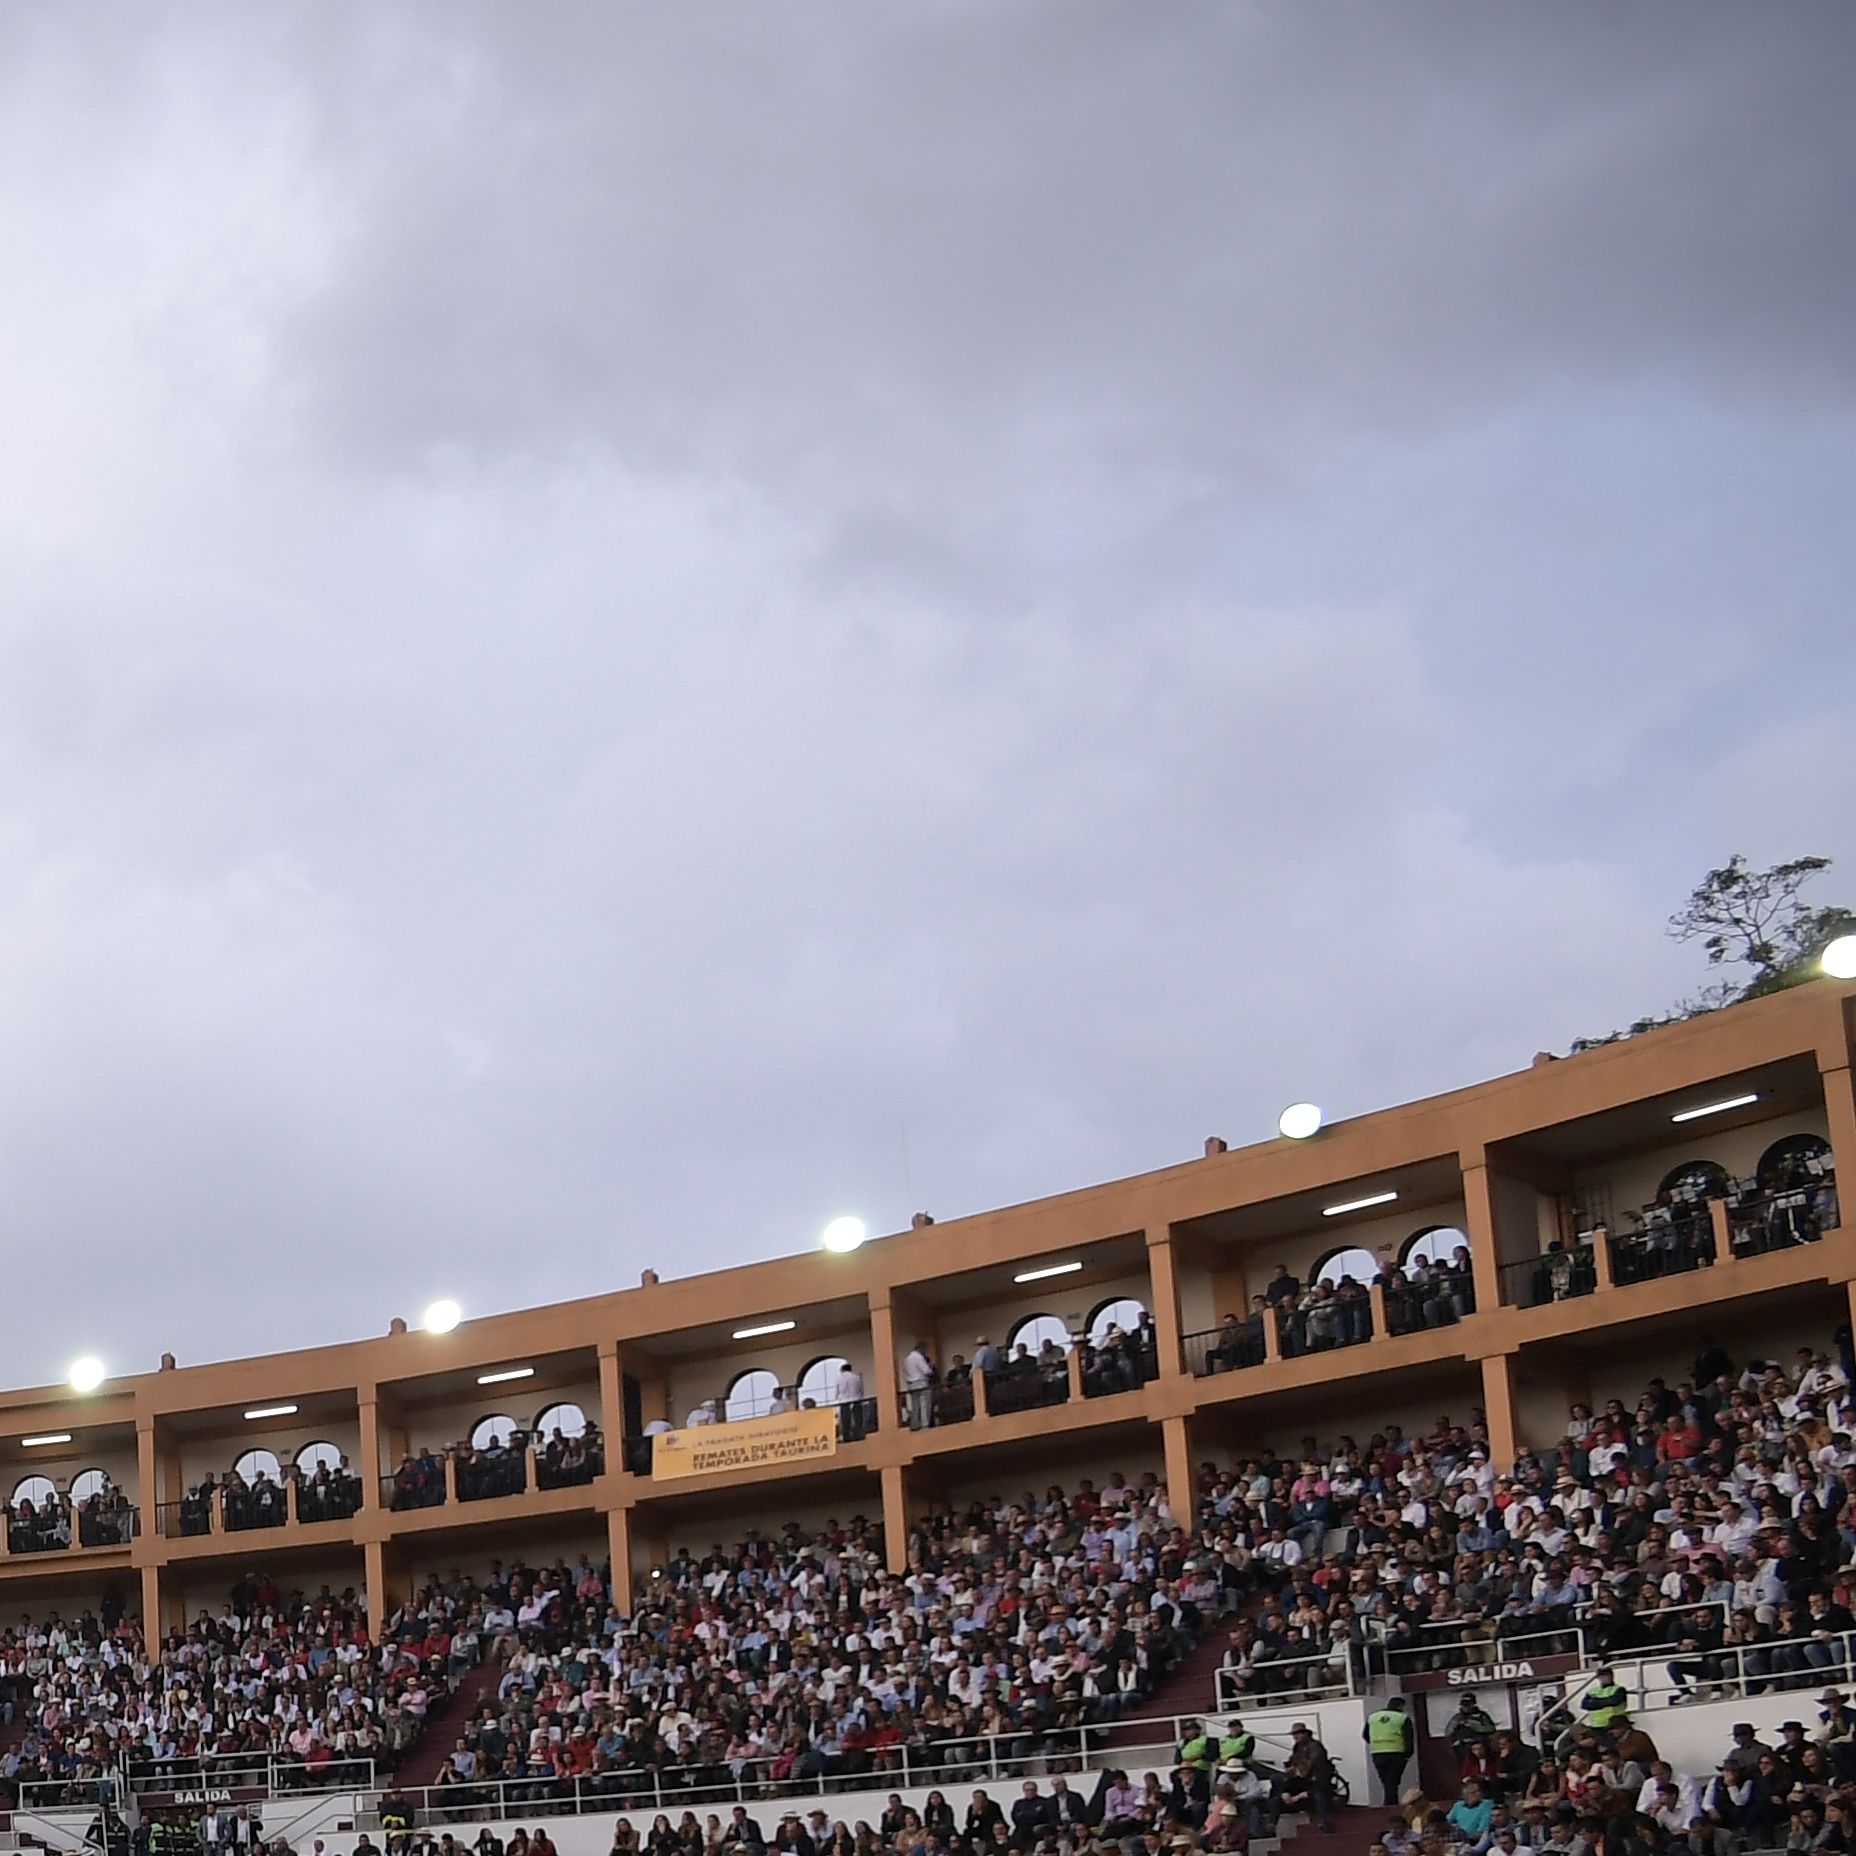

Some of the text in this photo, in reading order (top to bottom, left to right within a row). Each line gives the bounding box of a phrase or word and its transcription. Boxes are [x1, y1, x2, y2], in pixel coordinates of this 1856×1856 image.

[692, 1447, 746, 1462] REMATES
[751, 1438, 809, 1453] DURANTE
[814, 1434, 829, 1445] LA
[692, 1443, 829, 1469] TEMPORADA TAURINA
[1447, 1662, 1534, 1685] SALIDA
[174, 1789, 231, 1804] SALIDA
